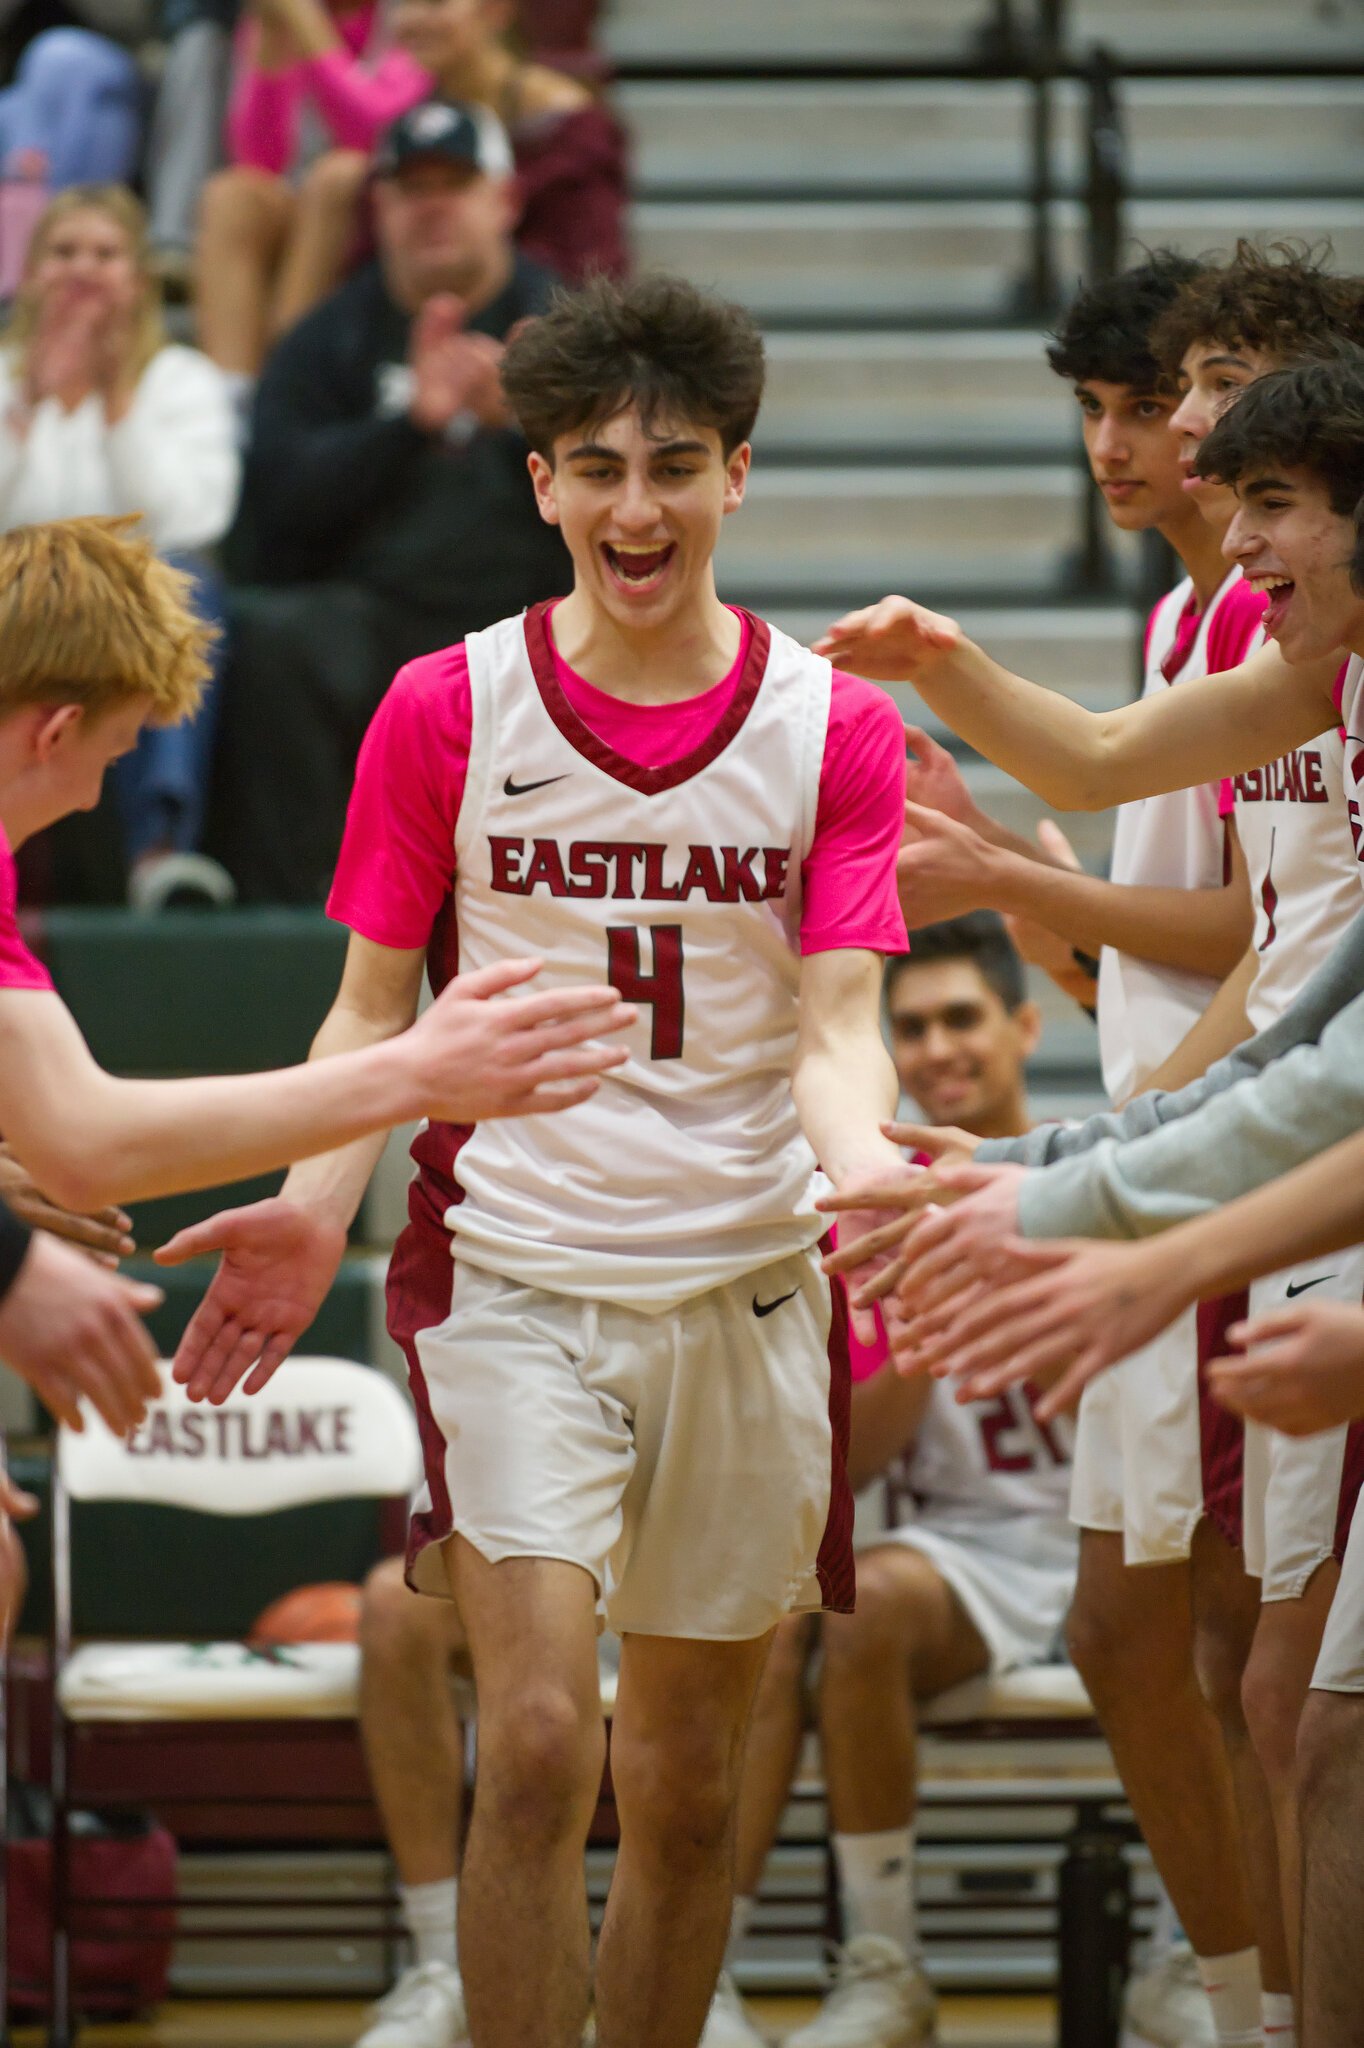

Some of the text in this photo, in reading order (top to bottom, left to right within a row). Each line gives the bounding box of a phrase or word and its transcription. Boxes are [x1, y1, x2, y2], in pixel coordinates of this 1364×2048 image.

[1233, 750, 1329, 803] ASTLAKE
[488, 836, 791, 902] EASTLAKE
[606, 924, 684, 1061] 4
